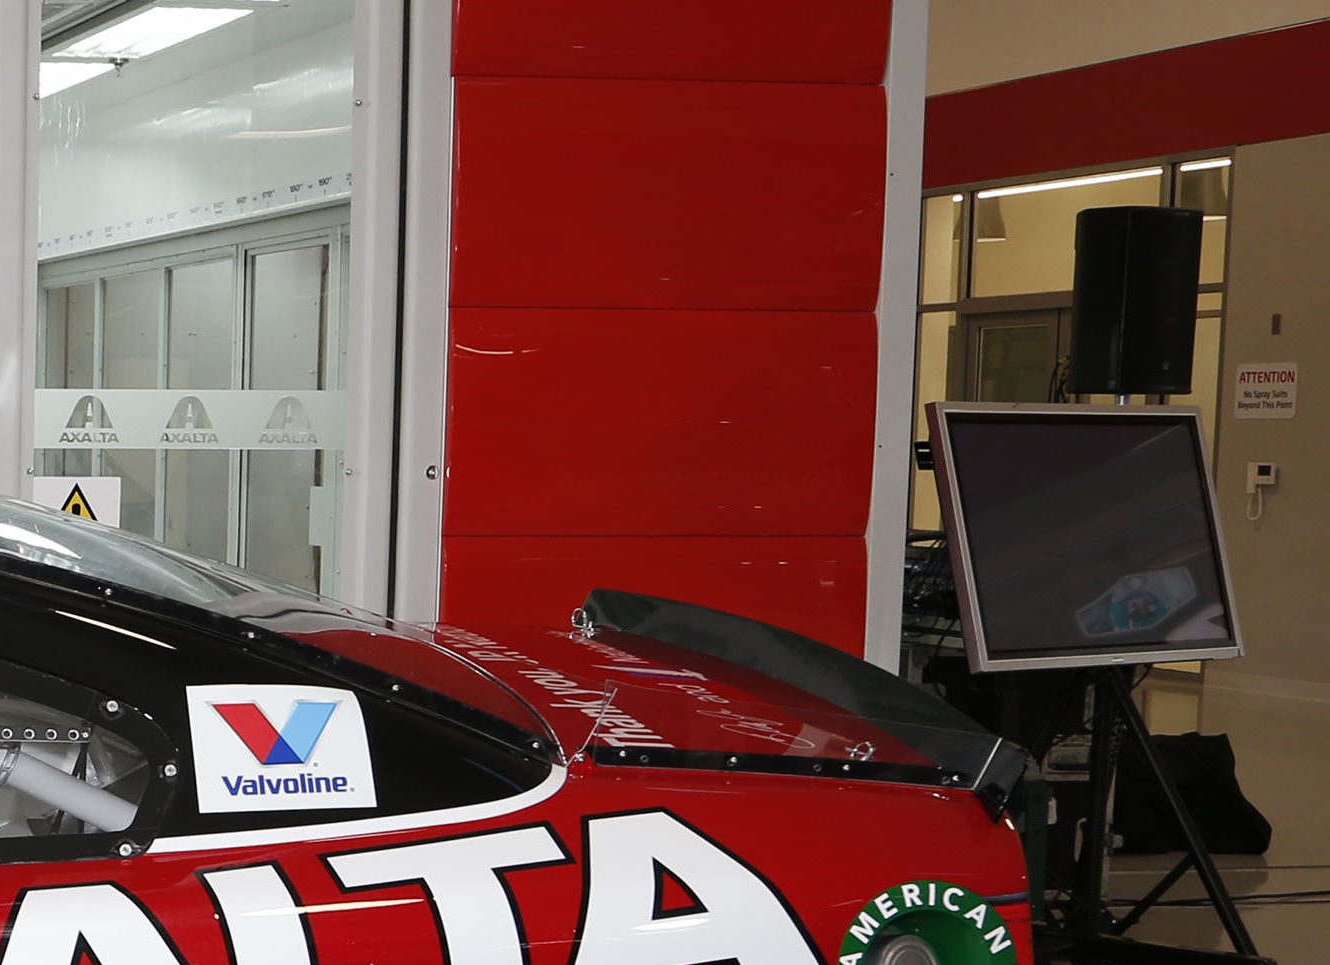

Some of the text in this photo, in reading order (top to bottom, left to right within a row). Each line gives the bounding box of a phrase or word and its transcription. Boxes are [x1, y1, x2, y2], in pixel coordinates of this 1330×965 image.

[1238, 371, 1296, 383] ATTENTION
[1262, 401, 1275, 409] This
[1276, 401, 1293, 409] Point
[59, 431, 119, 443] AXALTA
[160, 431, 219, 444] AXALTA
[258, 432, 318, 444] AXALTA
[550, 699, 675, 749] Thank
[221, 773, 348, 796] Valvoline
